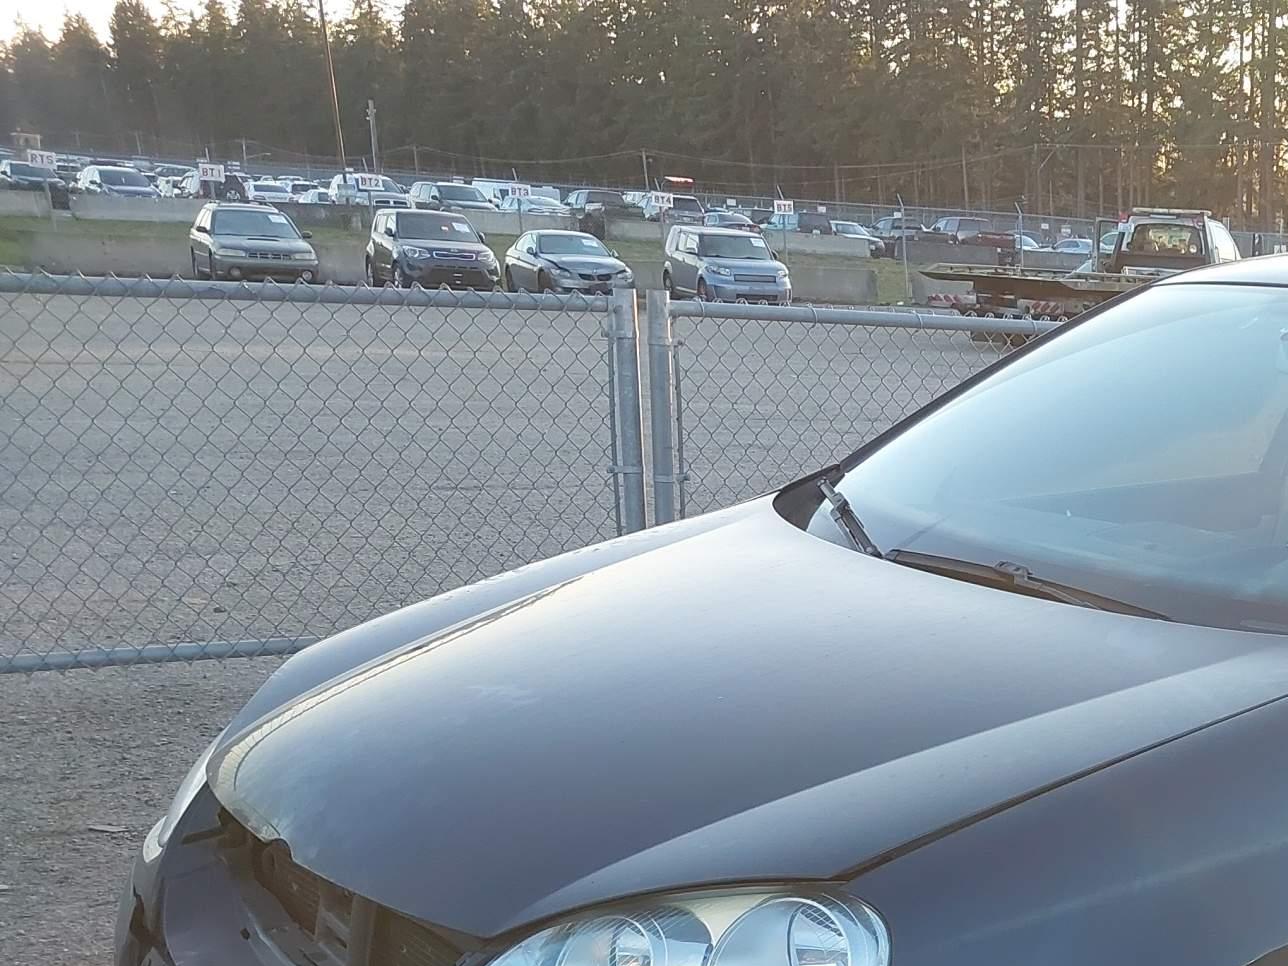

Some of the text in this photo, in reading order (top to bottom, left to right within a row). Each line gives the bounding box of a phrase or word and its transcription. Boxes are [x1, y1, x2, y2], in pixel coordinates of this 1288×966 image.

[360, 175, 380, 187] BT2
[511, 187, 529, 196] BT3
[654, 195, 671, 204] BT4
